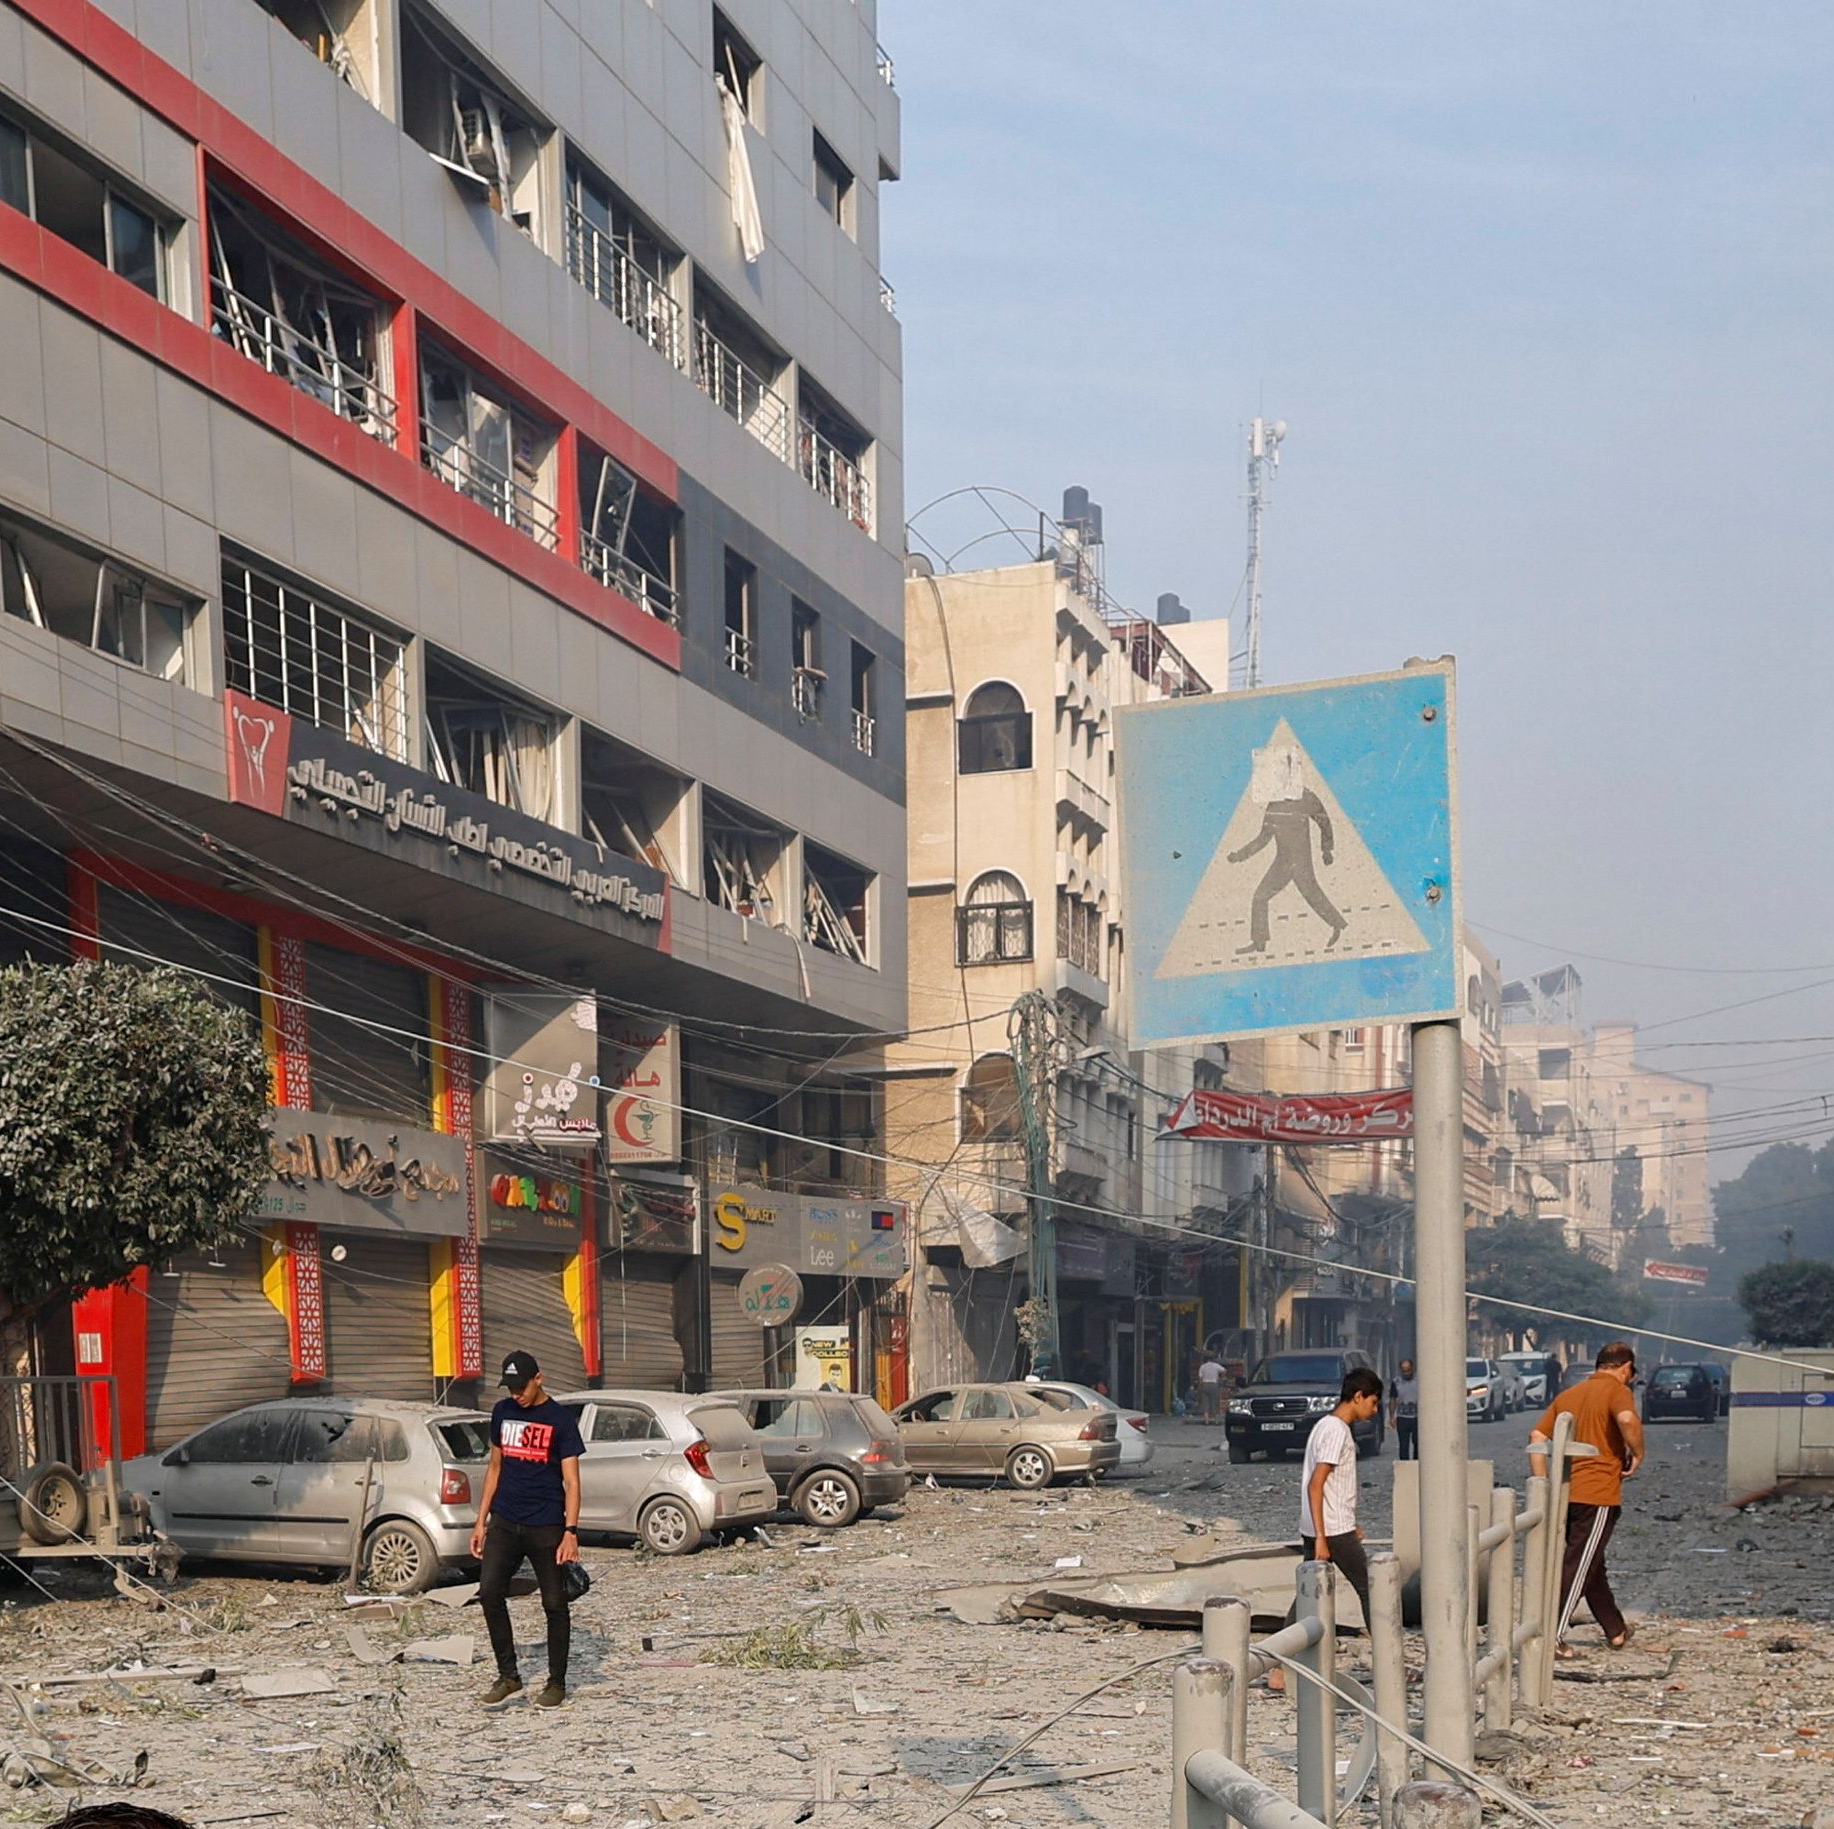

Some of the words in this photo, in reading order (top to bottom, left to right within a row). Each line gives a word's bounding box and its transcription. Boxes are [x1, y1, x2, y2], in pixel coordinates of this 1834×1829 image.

[445, 816, 488, 857] لطب
[487, 836, 572, 886] التخصصي
[1285, 1105, 1352, 1135] وروضة
[1356, 1101, 1414, 1133] ركز
[714, 1191, 777, 1251] SMART
[810, 1245, 834, 1266] Lee
[501, 1421, 548, 1449] DIESEL
